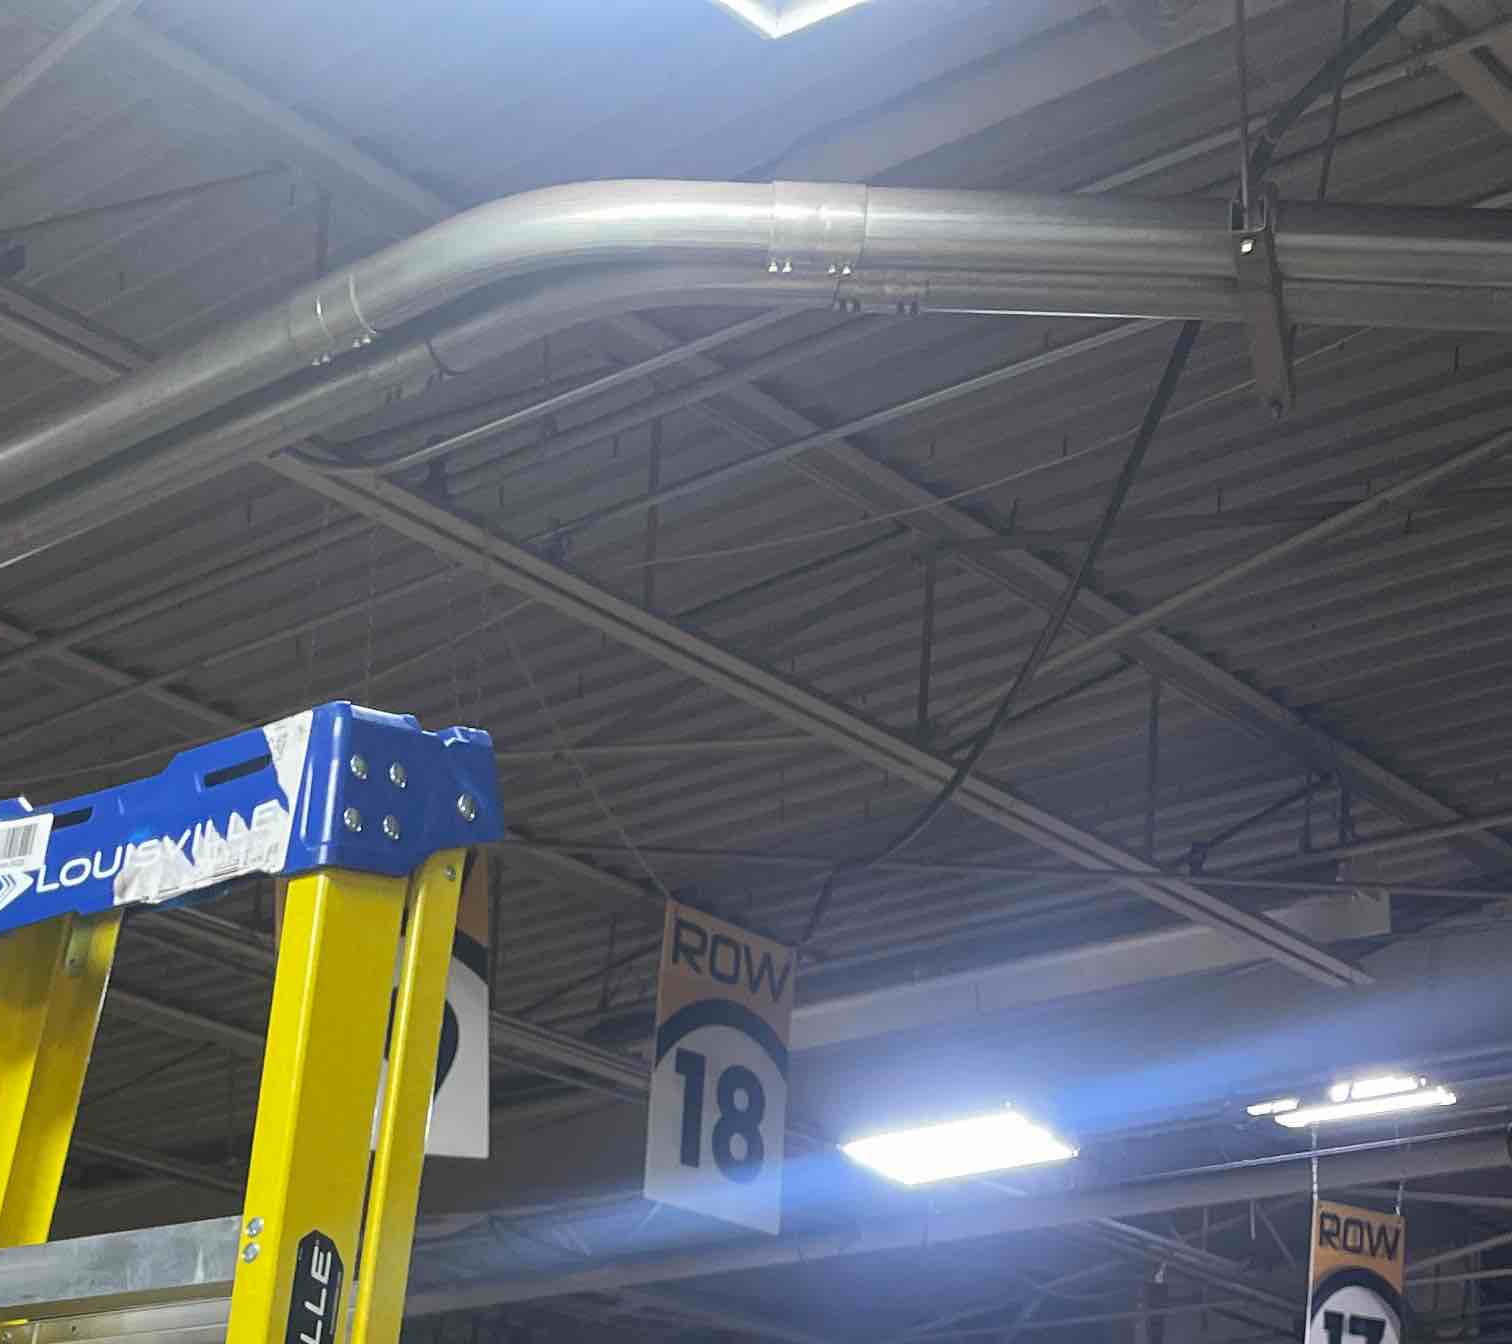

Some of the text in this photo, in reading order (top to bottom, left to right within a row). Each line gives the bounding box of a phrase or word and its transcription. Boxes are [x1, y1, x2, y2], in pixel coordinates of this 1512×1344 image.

[670, 917, 793, 1000] ROW
[675, 1048, 767, 1185] 18
[1319, 1210, 1405, 1262] ROW
